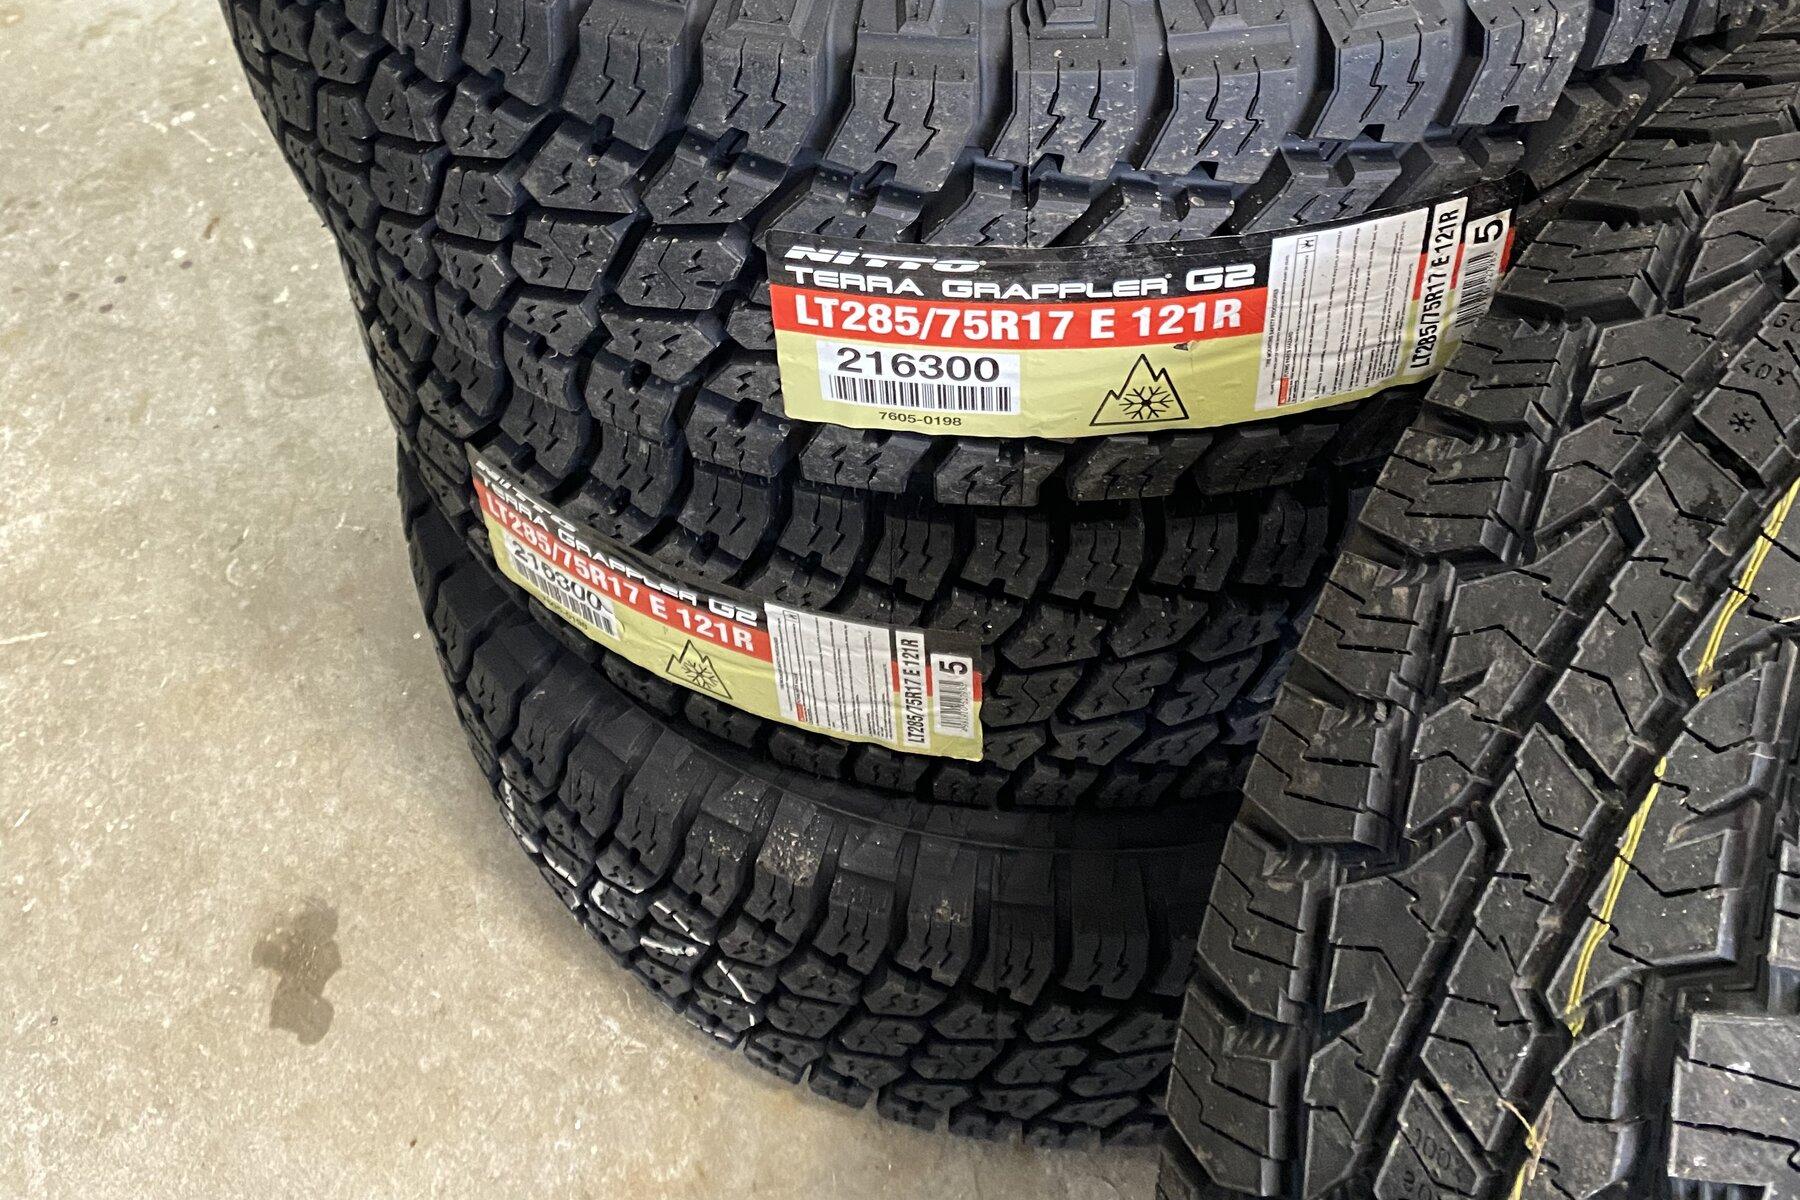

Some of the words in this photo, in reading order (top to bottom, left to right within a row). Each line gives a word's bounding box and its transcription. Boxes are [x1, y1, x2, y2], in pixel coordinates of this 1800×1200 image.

[1435, 209, 1459, 253] 121R
[1474, 219, 1504, 244] 5
[784, 246, 979, 272] NITTO
[1431, 256, 1450, 269] E
[784, 265, 924, 297] TERRA
[942, 278, 1168, 300] GRAPPLER
[1187, 263, 1257, 291] G2
[796, 295, 1073, 341] LT285/75R17
[1091, 305, 1116, 339] E
[1132, 299, 1242, 337] 121R
[1410, 271, 1445, 369] LT285/75R17
[837, 348, 1000, 382] 216300
[879, 411, 962, 426] 7605-0198
[482, 475, 549, 531] TERRA
[558, 528, 698, 606] GRAPPLER
[708, 598, 758, 627] G2
[485, 493, 639, 605] LT285/75R17
[649, 595, 669, 620] E
[676, 608, 754, 652] 121R
[901, 638, 919, 668] 121R
[939, 660, 968, 675] 5
[908, 668, 920, 677] E
[903, 679, 925, 744] LT285/75R17
